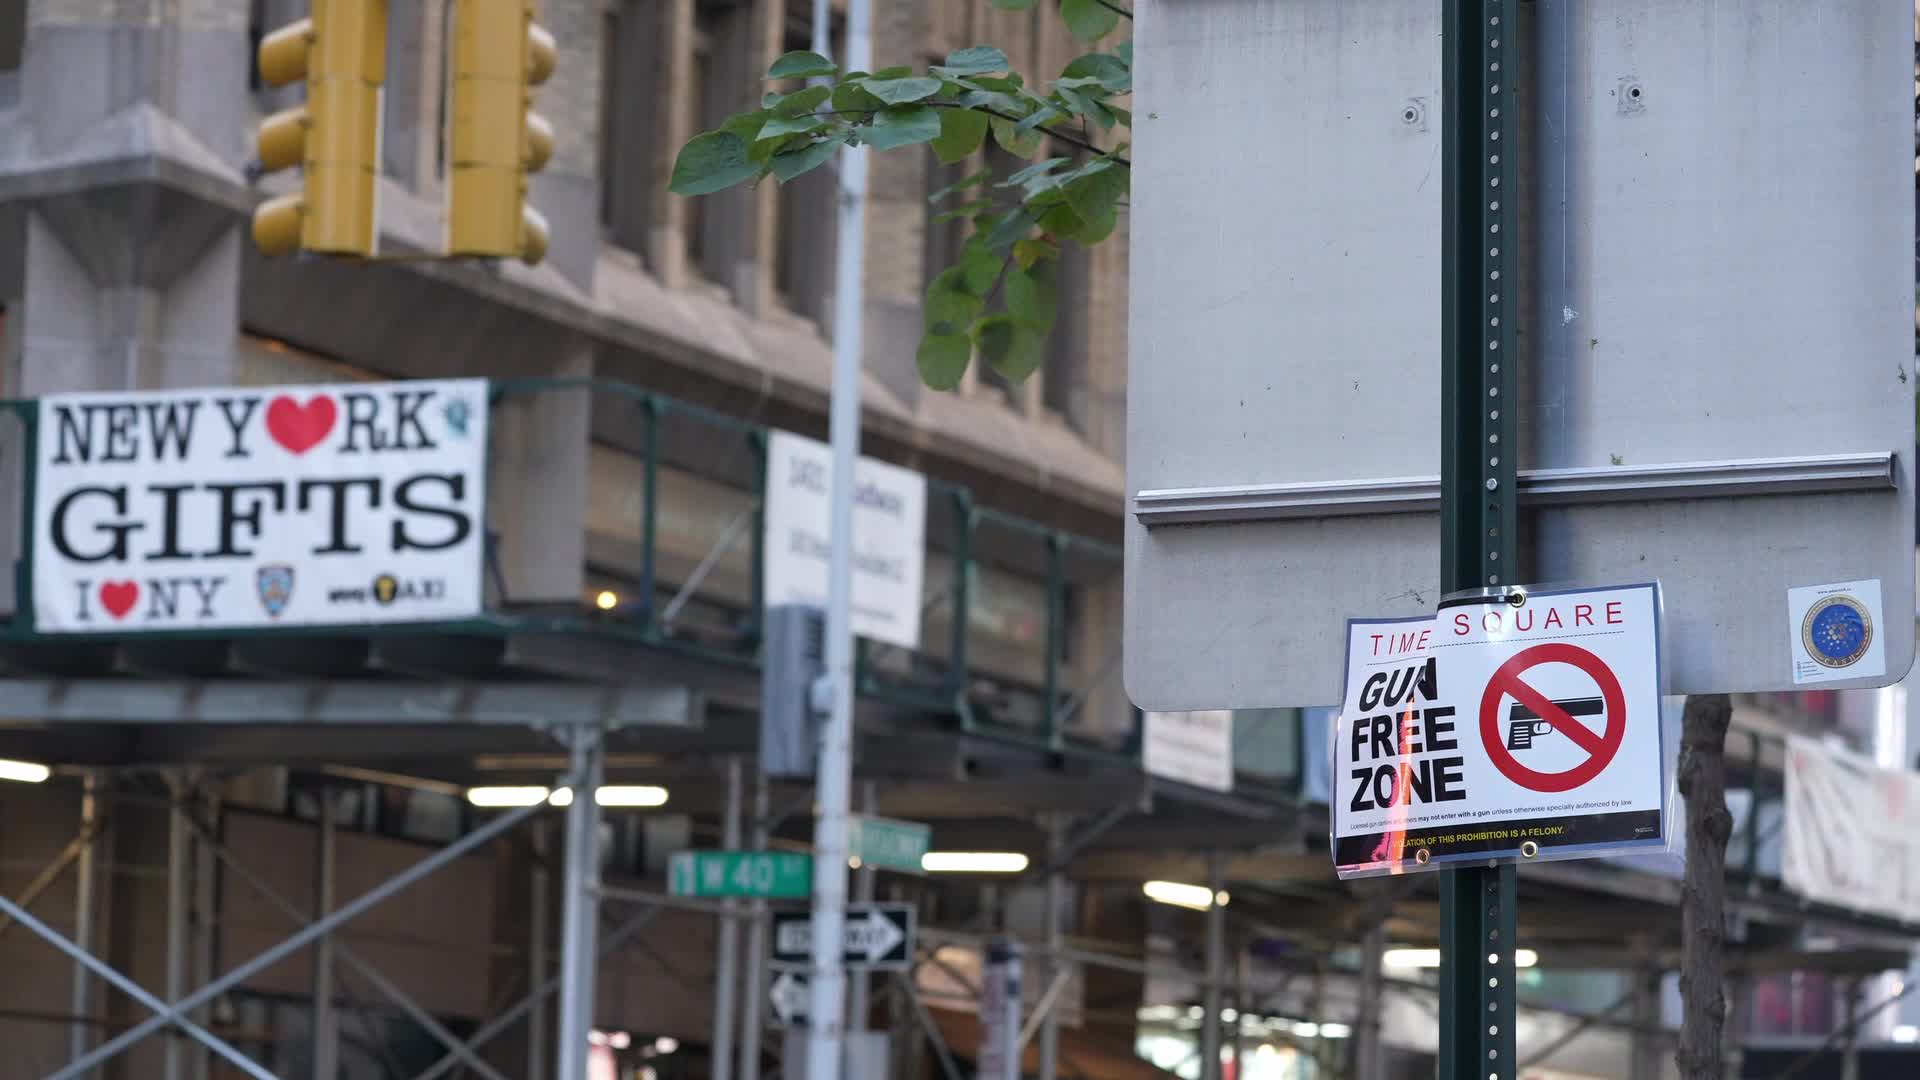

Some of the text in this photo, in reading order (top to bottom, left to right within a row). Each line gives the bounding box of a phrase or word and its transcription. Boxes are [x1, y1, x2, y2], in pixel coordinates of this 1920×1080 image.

[52, 401, 198, 464] NEW
[49, 474, 472, 563] GIFTS
[75, 577, 228, 620] I NY
[1370, 602, 1624, 656] TIME SQUARE
[1359, 657, 1438, 712] GUN
[1352, 706, 1458, 762] FREE
[1351, 756, 1467, 812] ZONE
[1477, 810, 1490, 818] gun
[1513, 805, 1545, 813] otherwise
[1547, 803, 1575, 811] specially
[1576, 800, 1609, 809] authorized
[1427, 836, 1437, 845] OF
[1438, 835, 1455, 843] THIS
[1456, 831, 1508, 841] PROHIBITION
[1510, 829, 1518, 837] IS
[1528, 826, 1565, 836] FELONY.
[702, 857, 724, 887] W
[732, 857, 775, 889] 40
